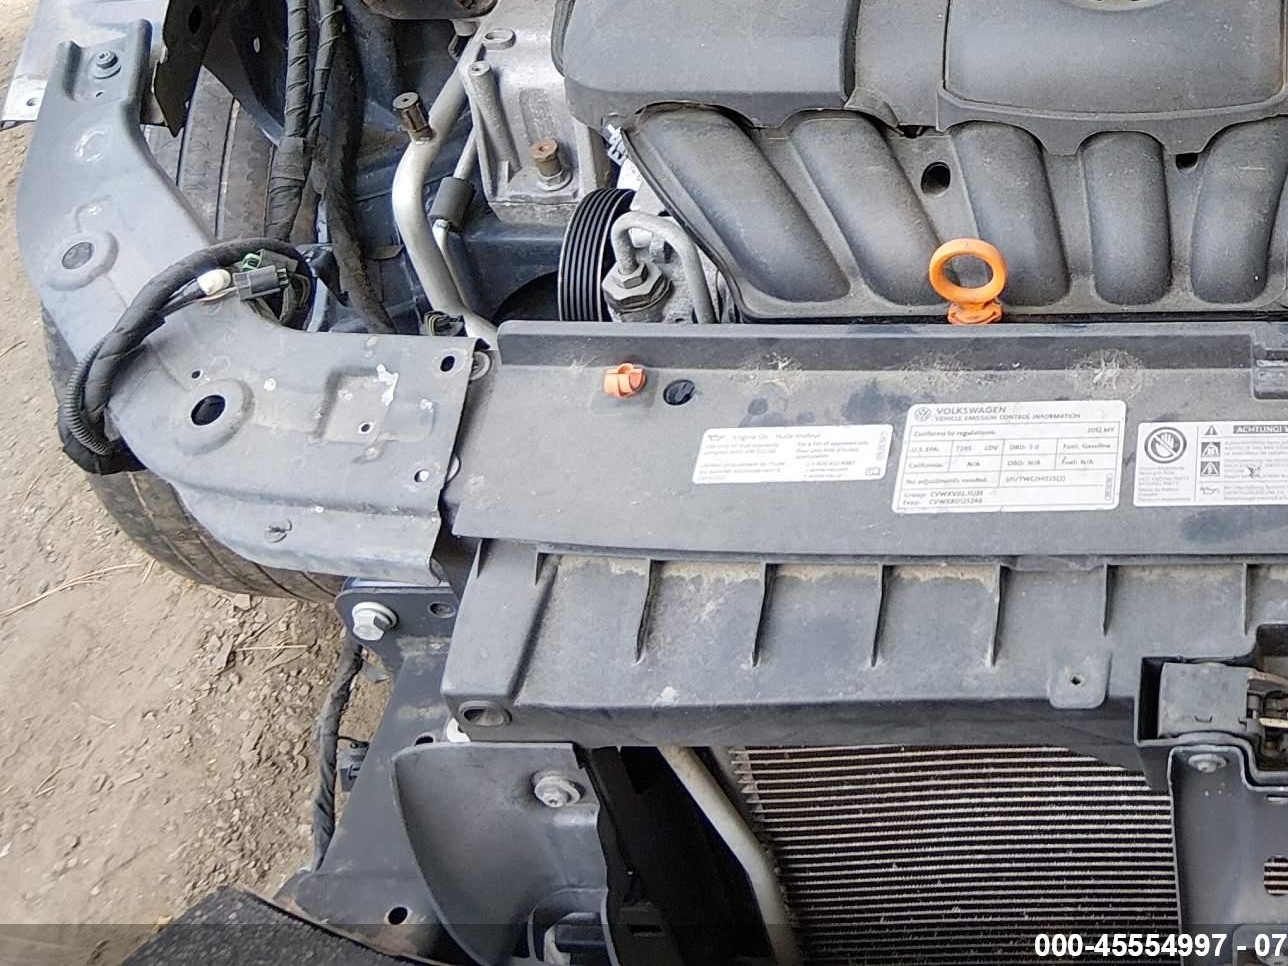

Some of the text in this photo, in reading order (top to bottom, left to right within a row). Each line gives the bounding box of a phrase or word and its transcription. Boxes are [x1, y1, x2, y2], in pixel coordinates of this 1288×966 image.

[936, 406, 1007, 415] VOLKSWAGEN
[1032, 412, 1081, 420] INFORMATION
[1236, 426, 1282, 434] ACHTUNG!
